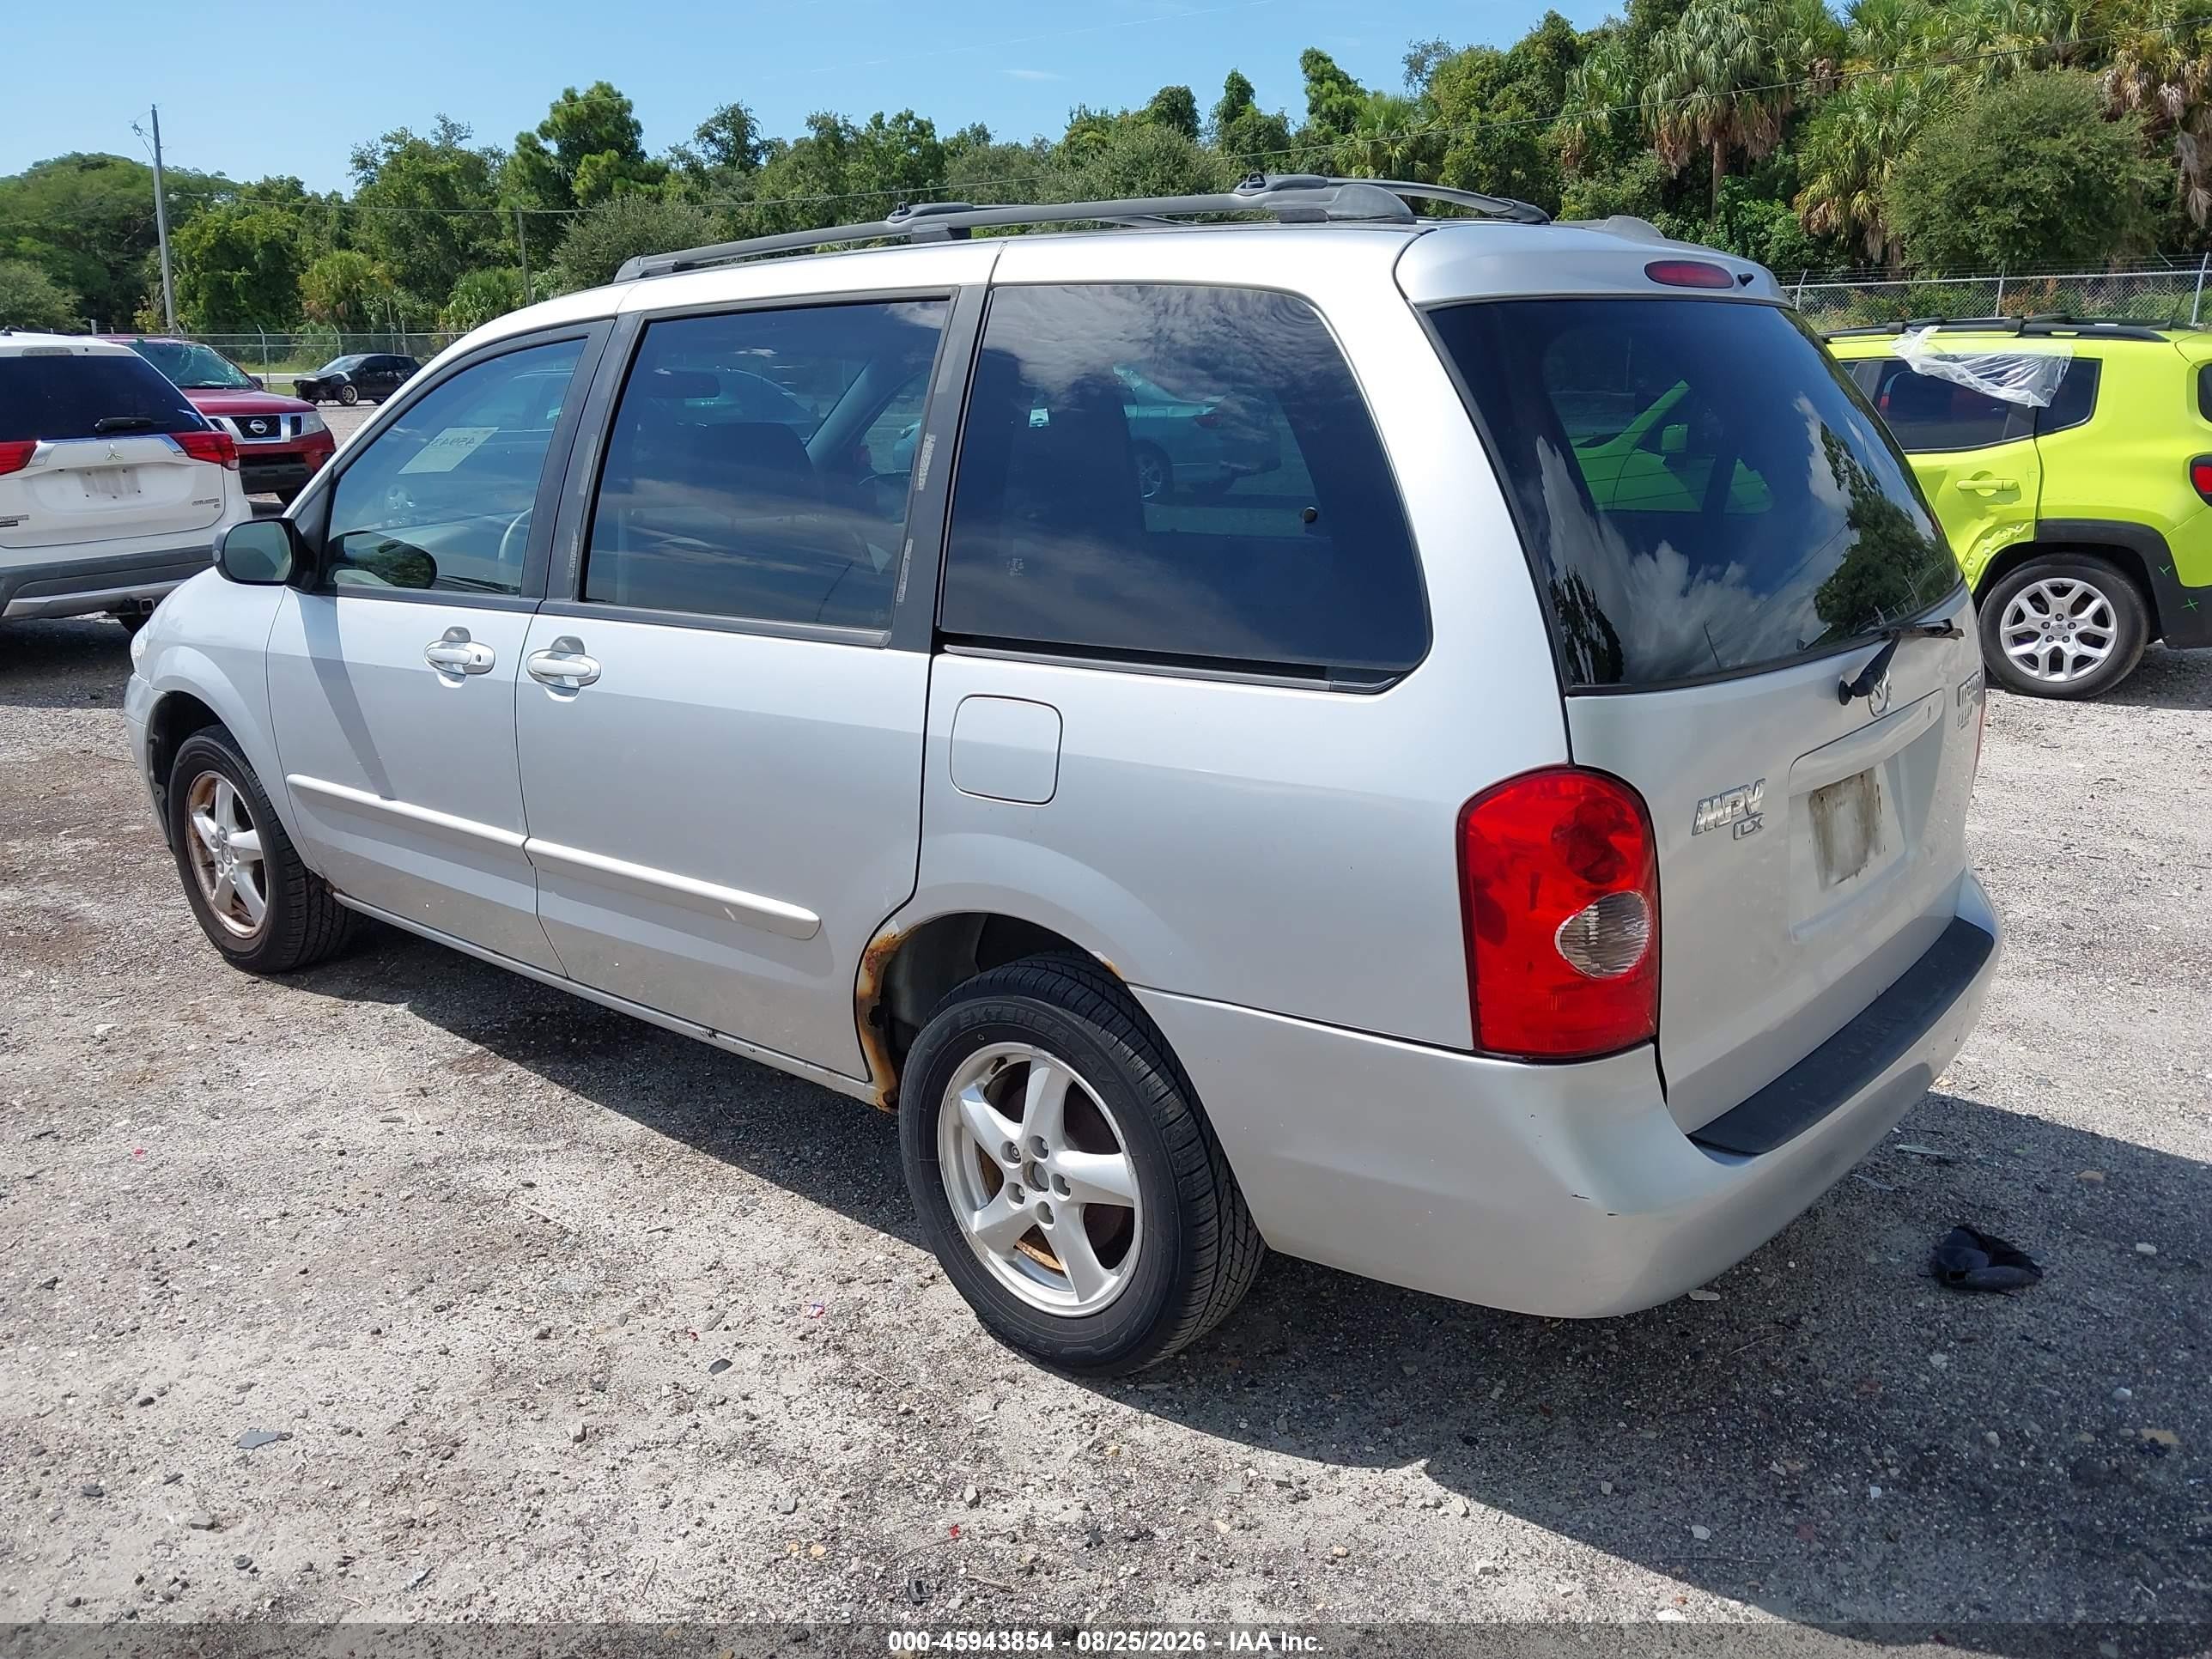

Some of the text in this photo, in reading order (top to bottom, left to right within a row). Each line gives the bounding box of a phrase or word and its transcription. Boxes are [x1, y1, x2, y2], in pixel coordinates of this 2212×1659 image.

[1692, 777, 1765, 836] MPV
[1740, 817, 1763, 836] LX
[958, 1005, 1071, 1045] EXTENSA
